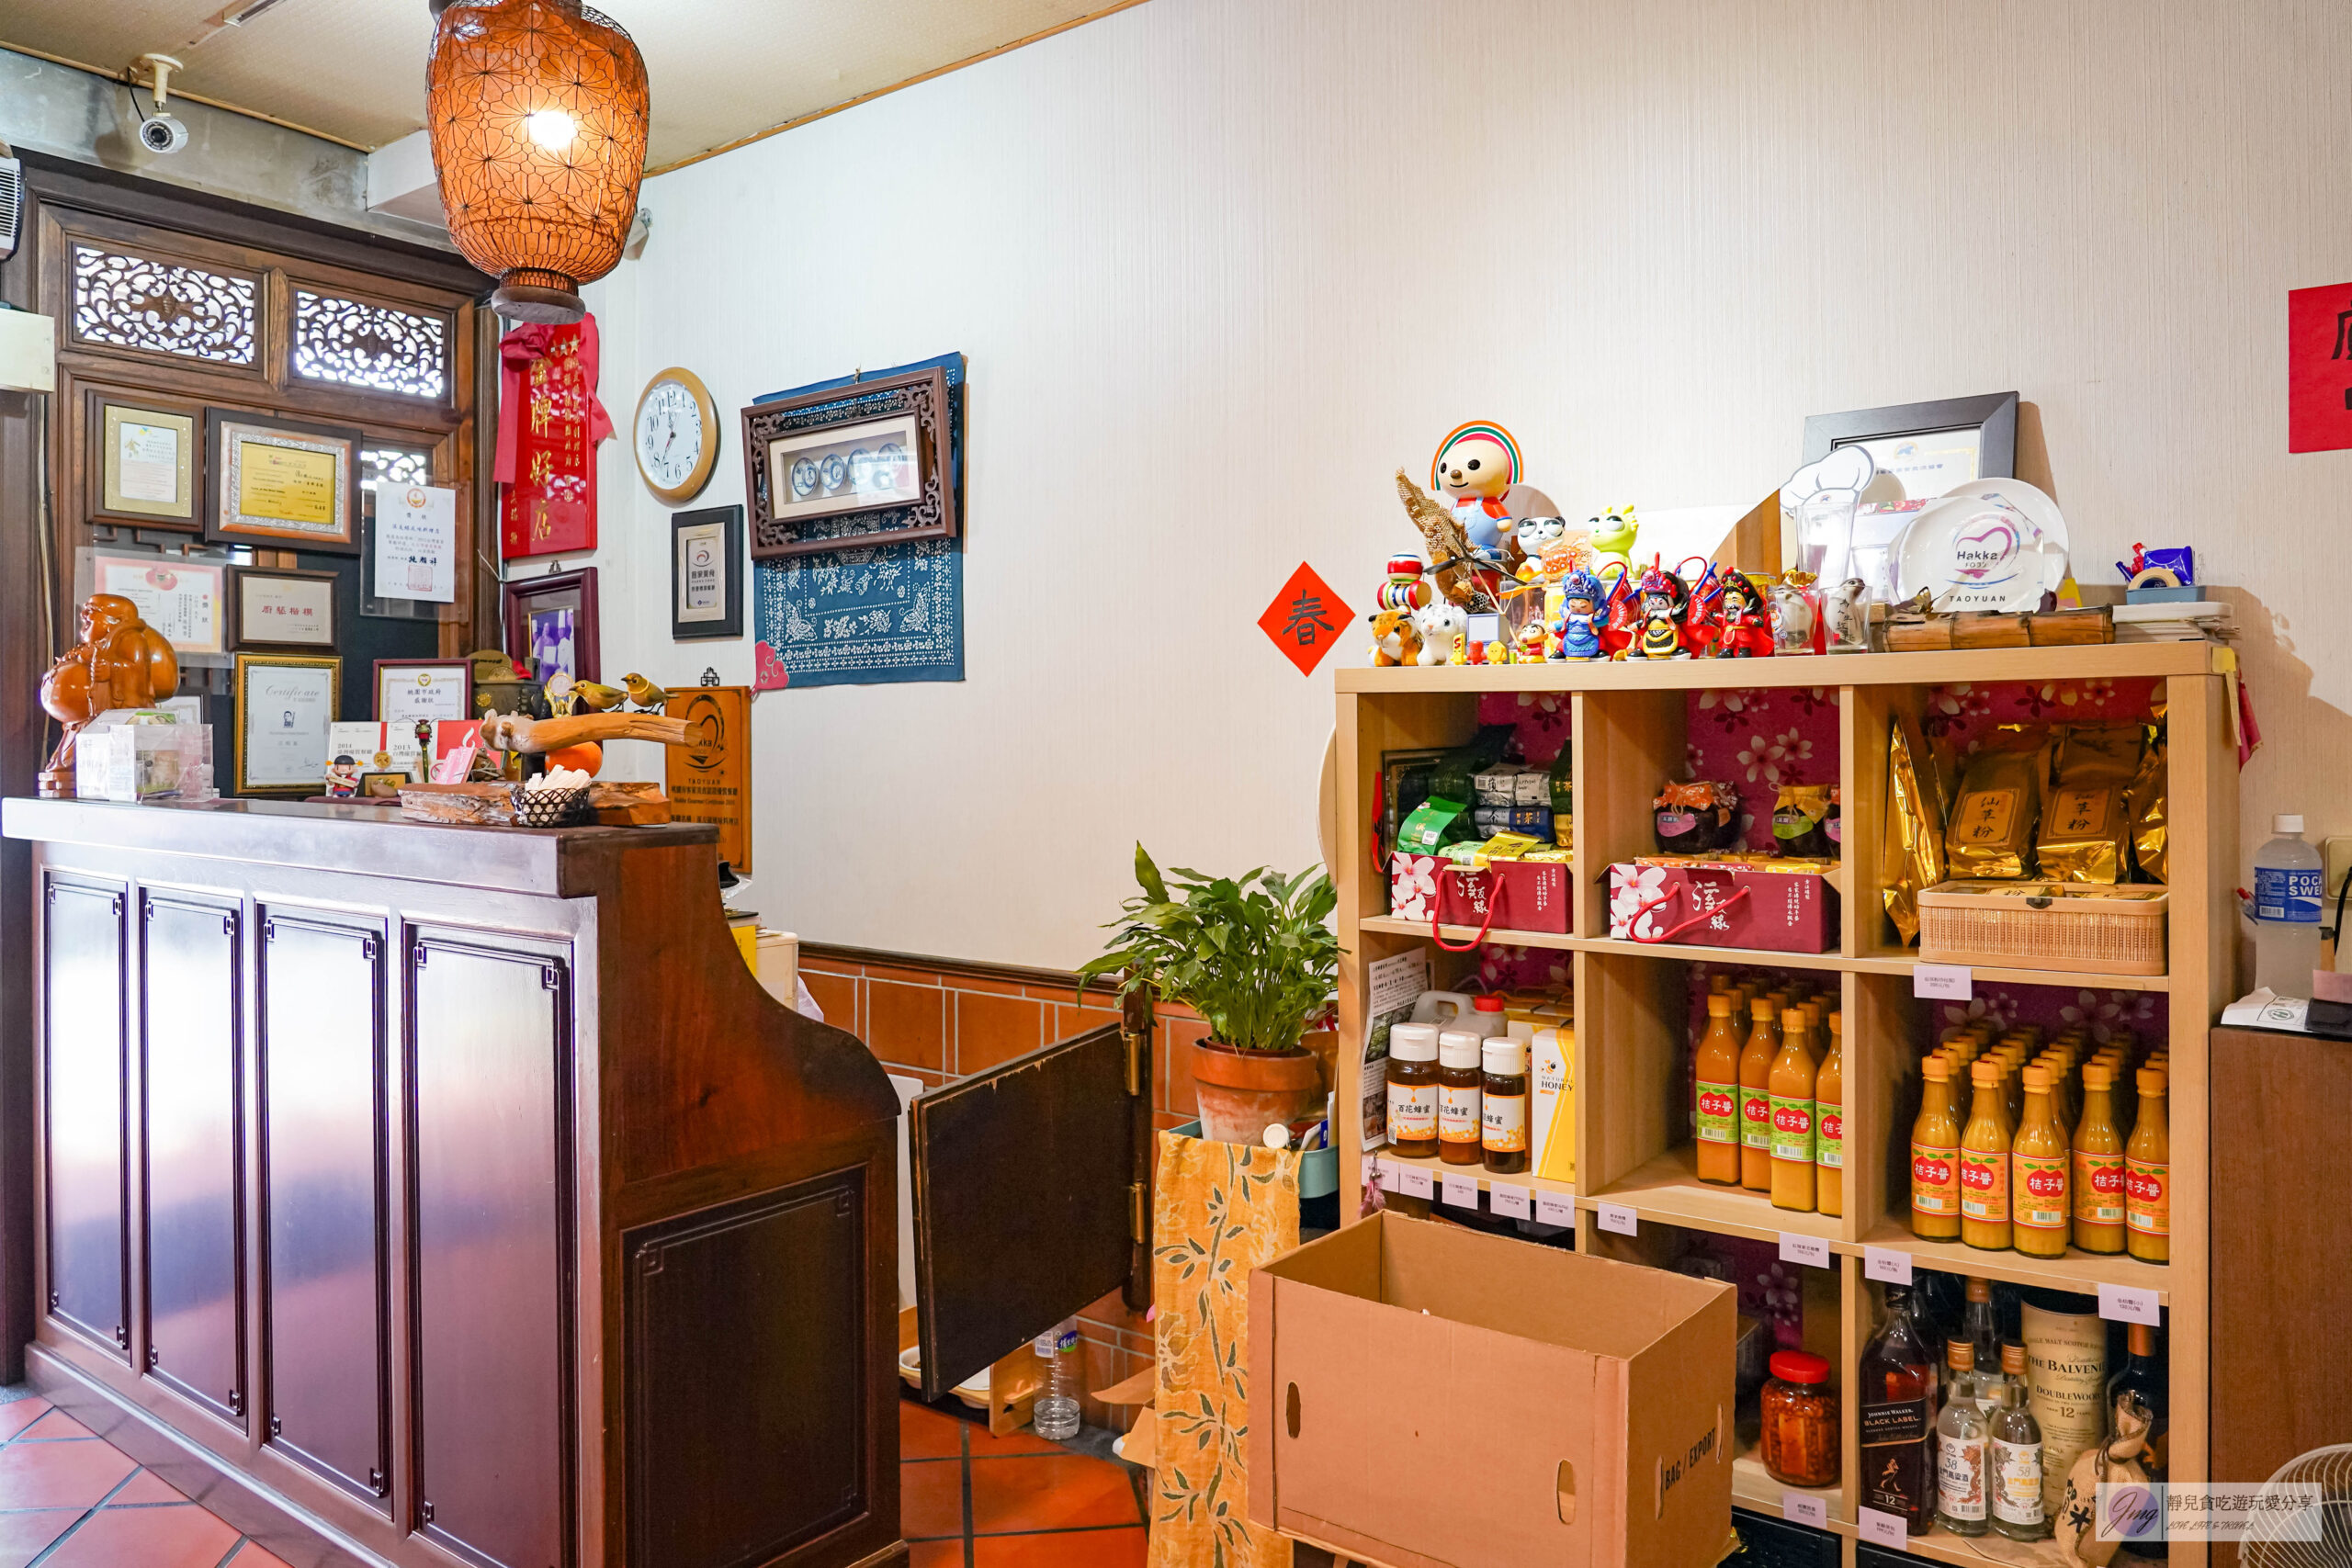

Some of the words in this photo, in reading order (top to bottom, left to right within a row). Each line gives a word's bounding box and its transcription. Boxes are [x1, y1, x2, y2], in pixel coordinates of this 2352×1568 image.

[667, 390, 677, 408] 12
[682, 391, 685, 408] 1
[658, 399, 666, 415] 11
[690, 401, 696, 417] 2
[648, 415, 659, 432] 10
[695, 420, 702, 435] 3
[530, 356, 554, 542] 金牌好店
[647, 434, 654, 449] 9
[694, 441, 699, 455] 4
[653, 452, 661, 468] 8
[686, 456, 693, 470] 5
[663, 462, 670, 479] 7
[674, 463, 682, 479] 6
[1956, 549, 1998, 561] Hakka
[1282, 589, 1335, 646] 春
[265, 684, 320, 698] Certificate
[1972, 795, 2000, 839] 仙草粉
[1541, 1080, 1575, 1092] HONEY
[1397, 1104, 1430, 1113] 百花蜂蜜
[1701, 1098, 1733, 1112] 桔子醬
[1747, 1104, 1769, 1117] 桔子
[1775, 1113, 1810, 1129] 桔子醬
[1824, 1122, 1842, 1134] 桔子
[1915, 1163, 1950, 1180] 桔子醬
[1962, 1168, 1993, 1185] 桔子醬
[2029, 1177, 2064, 1191] 桔子醬
[2127, 1177, 2160, 1197] 桔子醬
[2028, 1355, 2044, 1369] THE
[2048, 1359, 2105, 1374] BALVENI
[1868, 1410, 1890, 1418] JOHNNIE
[2060, 1406, 2075, 1419] 12
[1864, 1418, 1891, 1427] BLACK
[1665, 1460, 1681, 1491] BAG
[1689, 1427, 1716, 1468] EXPORT
[1945, 1457, 1958, 1470] 38
[2017, 1466, 2030, 1477] 58
[1885, 1495, 1895, 1506] 12
